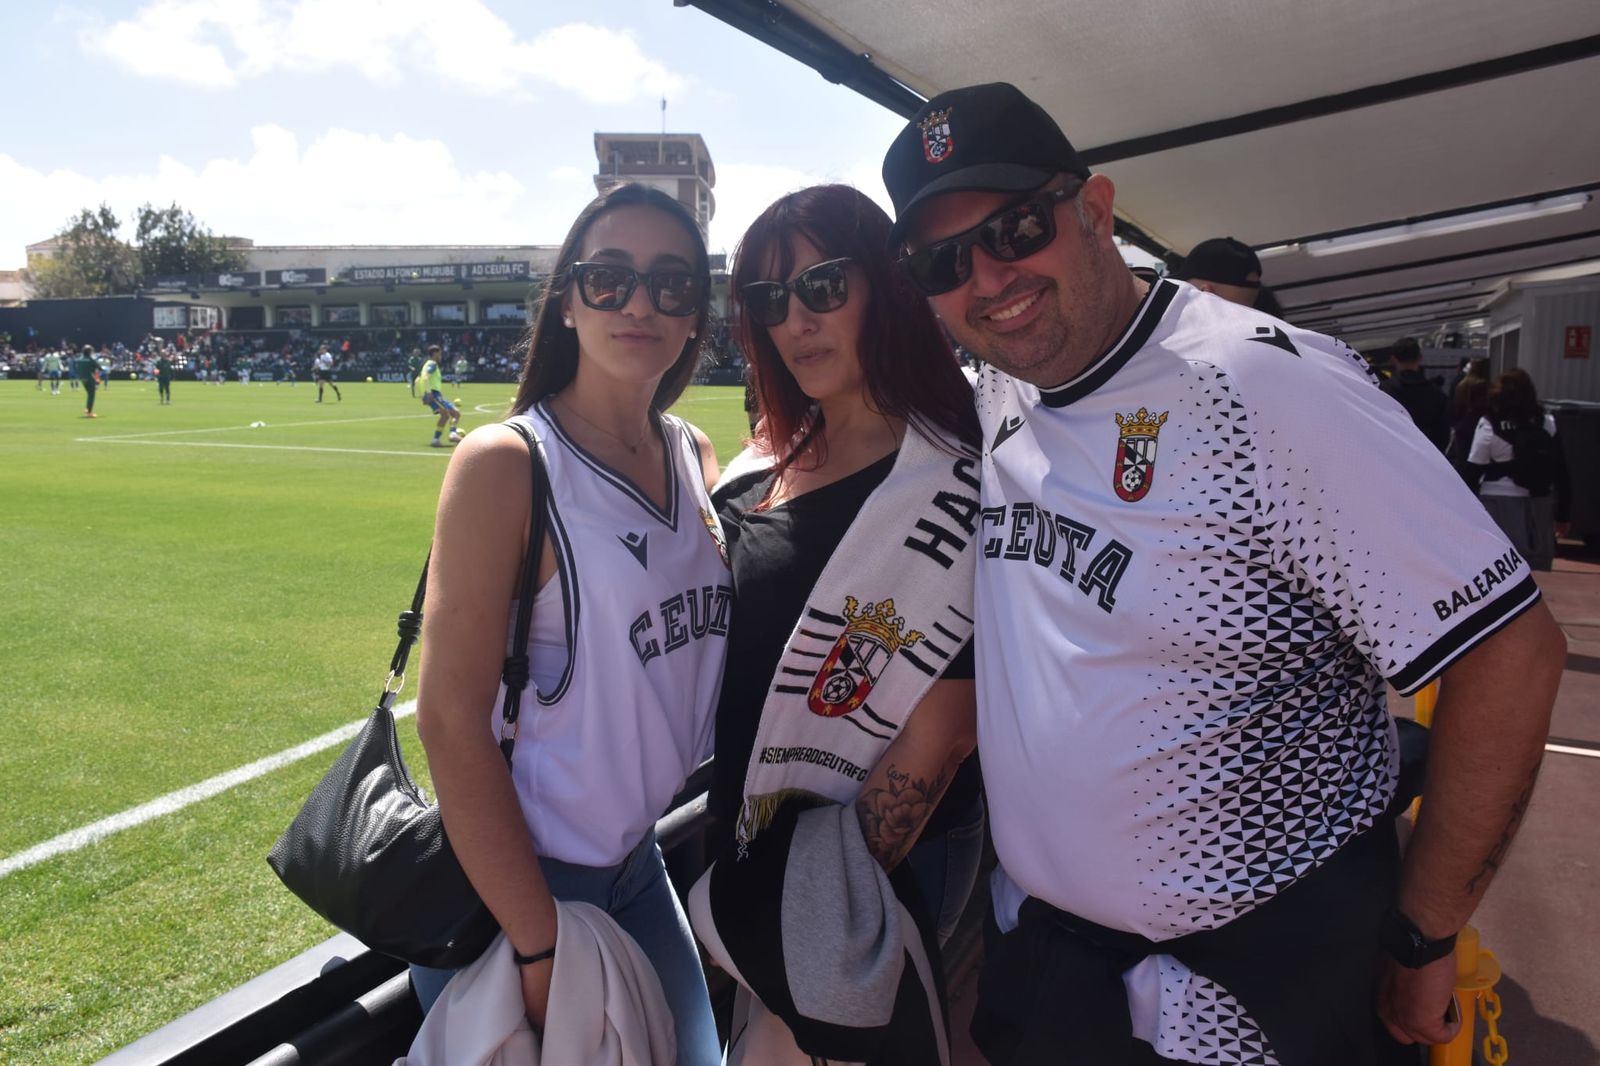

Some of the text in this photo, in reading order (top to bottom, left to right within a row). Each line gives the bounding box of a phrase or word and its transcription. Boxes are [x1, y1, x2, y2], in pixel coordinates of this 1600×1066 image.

[354, 266, 455, 280] ESTADIO ALFONO MURUBE
[472, 263, 524, 275] AD CEUTA FC
[981, 502, 1133, 614] CEUTA
